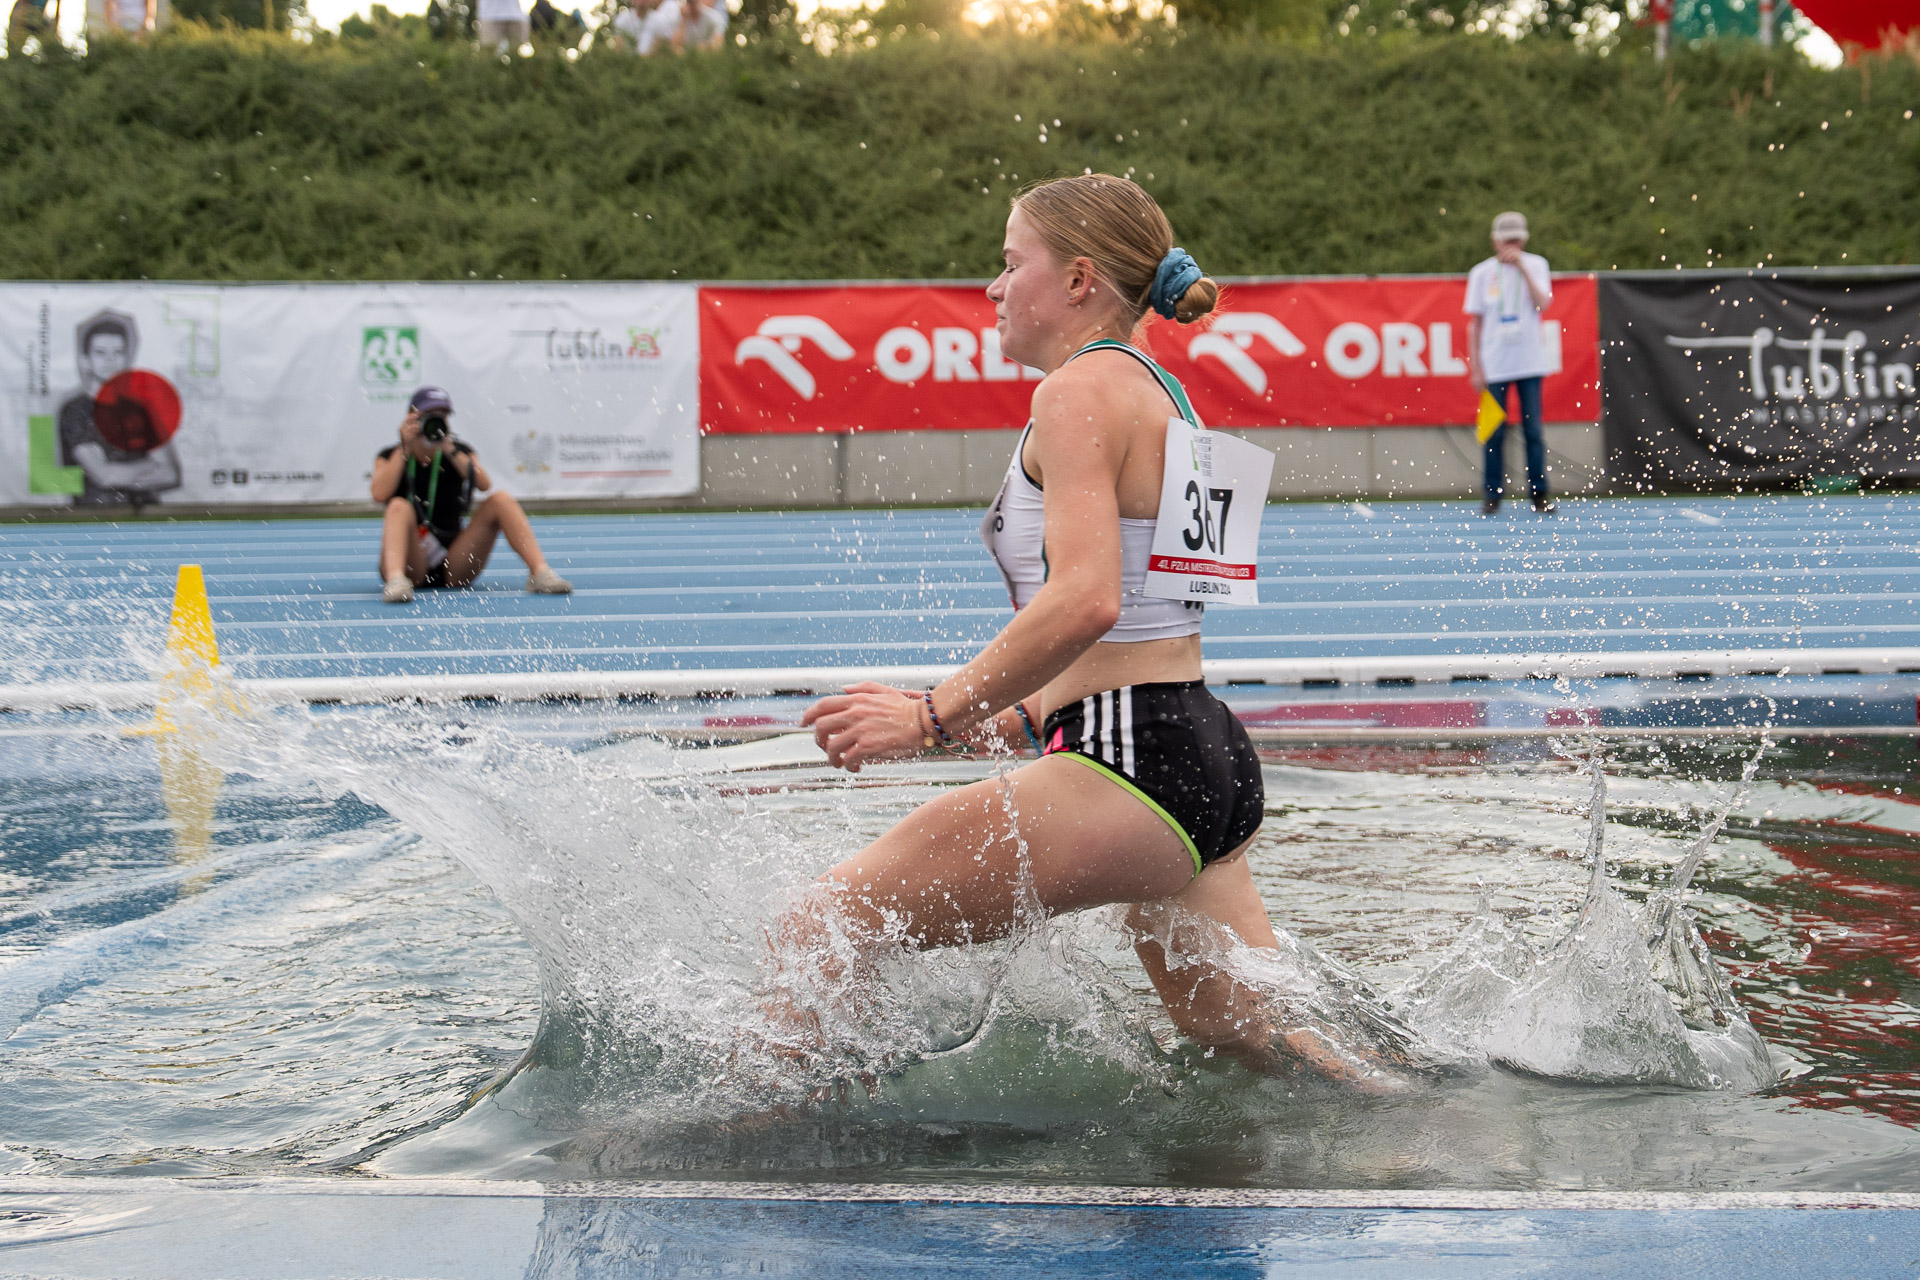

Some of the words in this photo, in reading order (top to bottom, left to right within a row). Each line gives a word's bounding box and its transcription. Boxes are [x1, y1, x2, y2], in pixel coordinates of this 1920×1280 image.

[874, 326, 1047, 383] ORL
[1325, 321, 1562, 378] ORL
[1182, 480, 1233, 555] 367
[1189, 581, 1219, 593] LUBLIN
